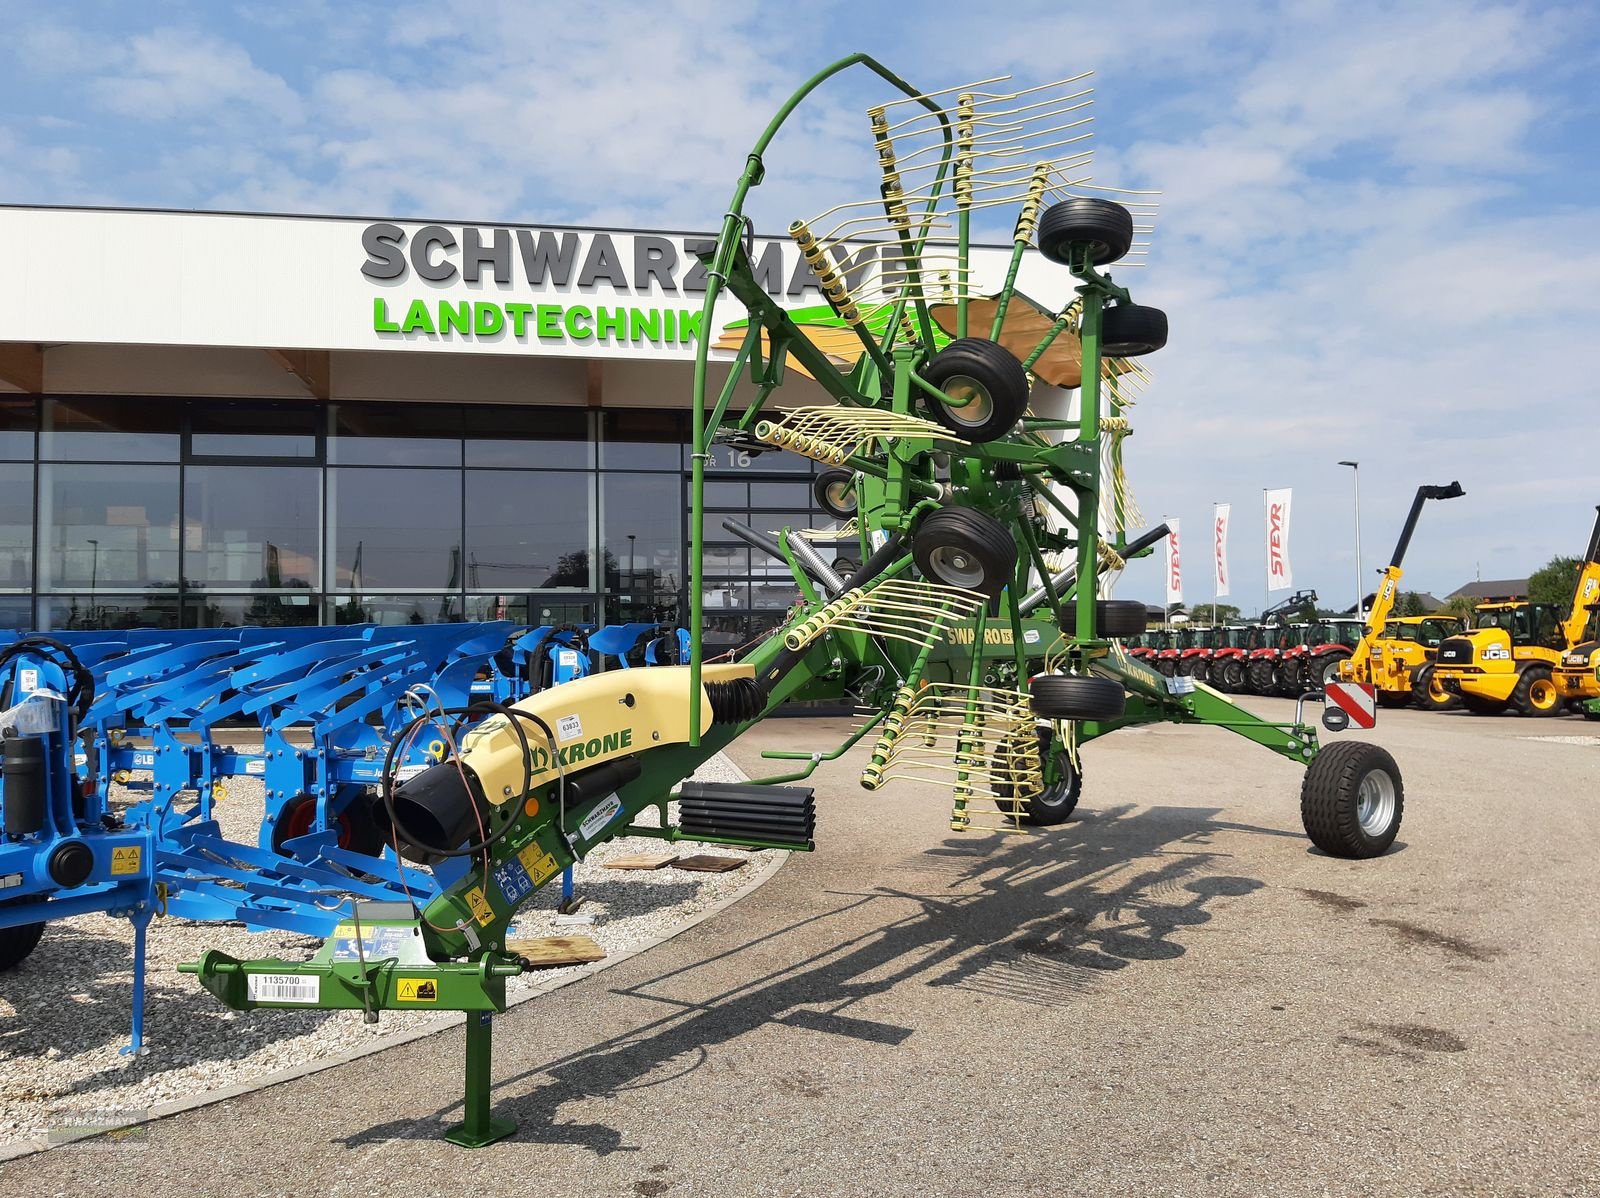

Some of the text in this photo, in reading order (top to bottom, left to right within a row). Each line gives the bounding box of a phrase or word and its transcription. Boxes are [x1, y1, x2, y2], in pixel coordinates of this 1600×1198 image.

[373, 297, 704, 343] LANDTECHNIK
[727, 450, 752, 468] 16
[1269, 503, 1284, 577] STEYR
[1168, 531, 1181, 592] STEYR
[1382, 579, 1395, 601] JCB
[1583, 577, 1594, 600] JCB
[947, 627, 1000, 645] SWARO
[1481, 649, 1510, 660] JCB
[1126, 662, 1156, 688] KRONE
[551, 728, 633, 770] KRONE
[582, 800, 615, 828] SCHWARZMAYR
[263, 976, 300, 985] 1135700
